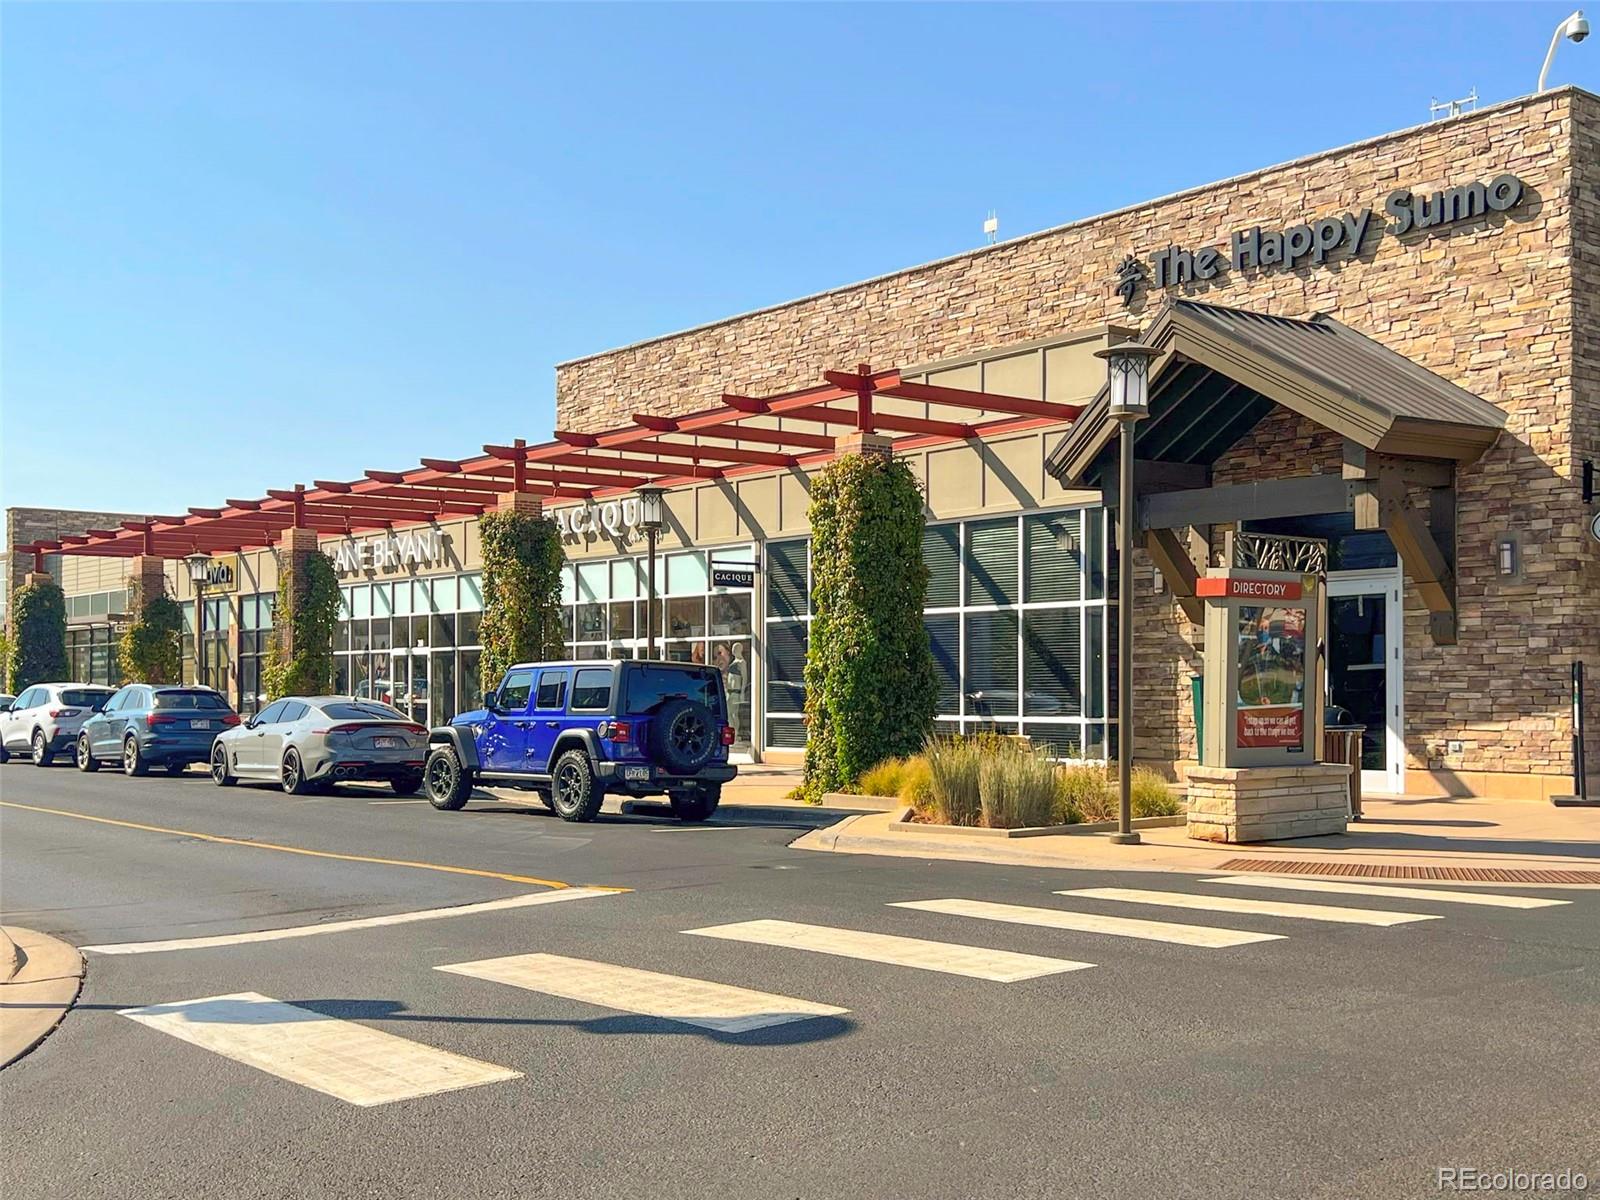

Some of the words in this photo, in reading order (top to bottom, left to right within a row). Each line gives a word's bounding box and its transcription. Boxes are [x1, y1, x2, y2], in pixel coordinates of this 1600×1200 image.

[1149, 245, 1218, 289] The
[1231, 208, 1372, 270] Happy
[1385, 173, 1522, 235] Sumo
[541, 500, 644, 537] ACIQU
[373, 530, 443, 567] BRYANT
[714, 572, 752, 583] CACIQUE
[1233, 581, 1286, 596] DIRECTORY
